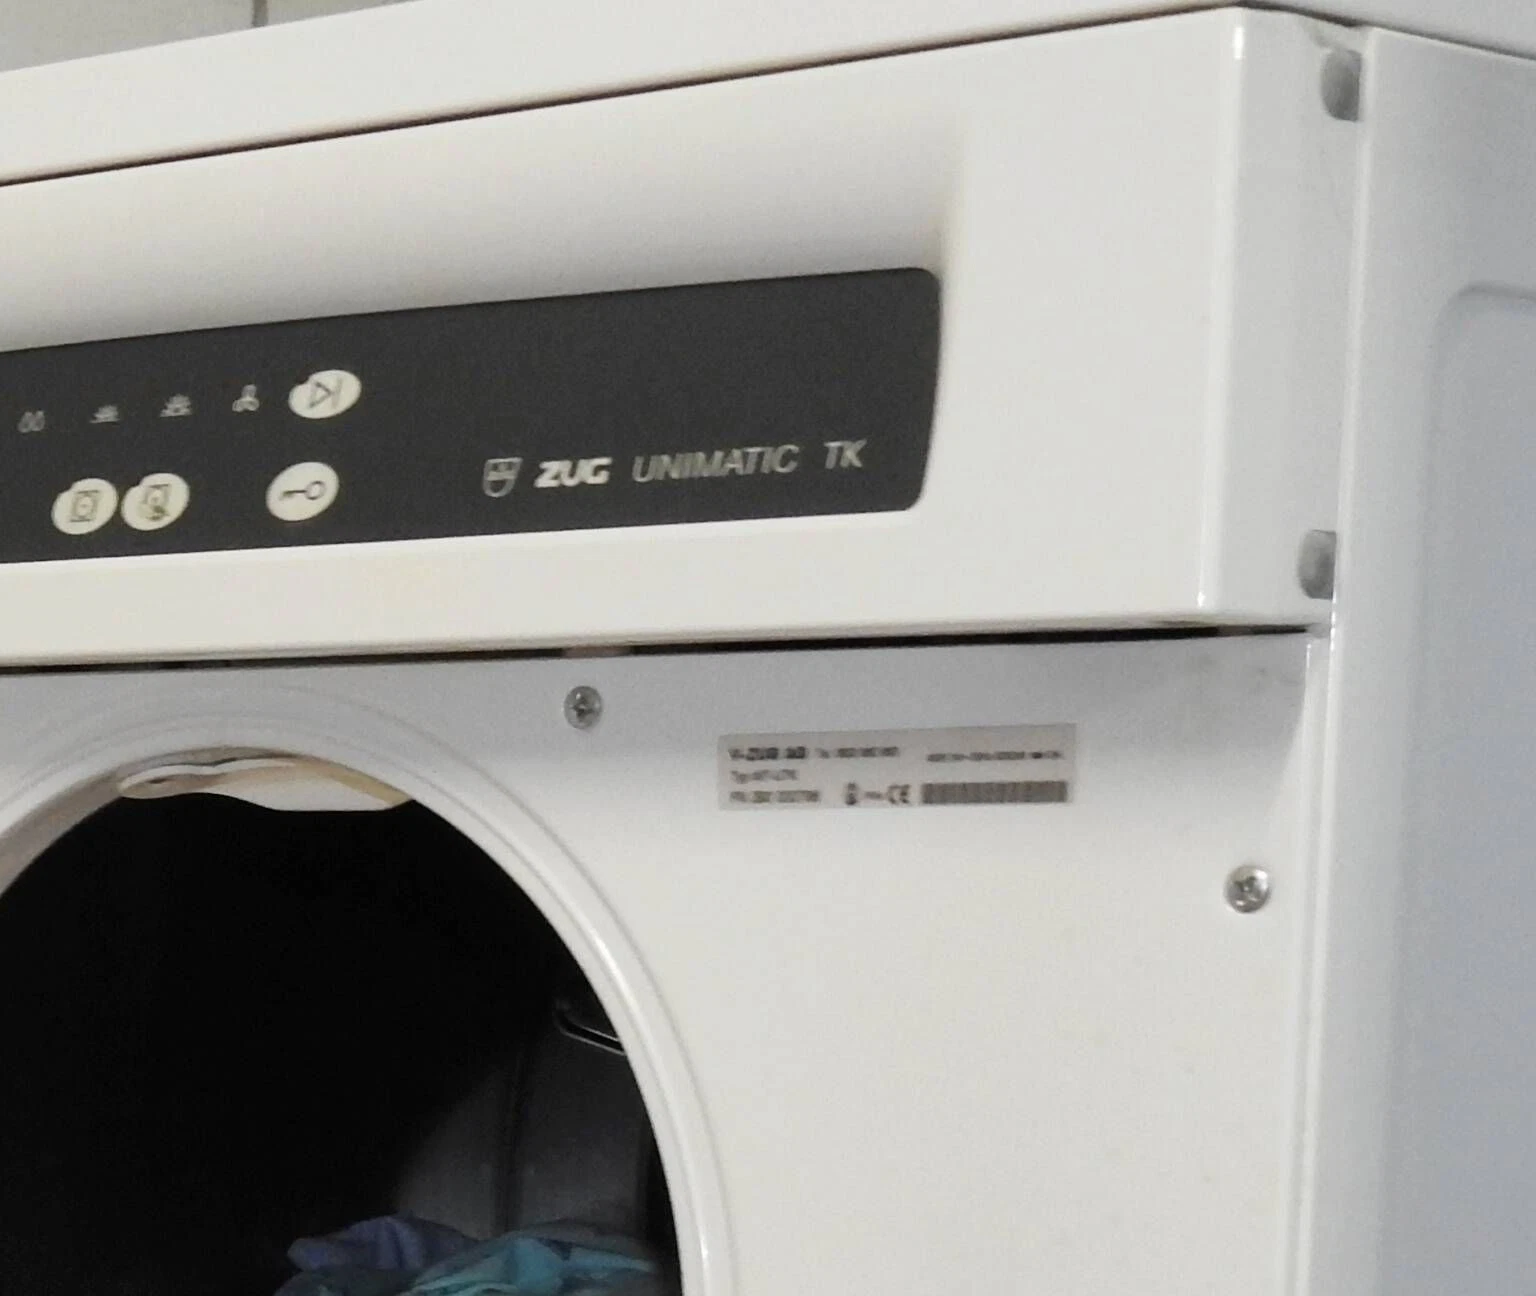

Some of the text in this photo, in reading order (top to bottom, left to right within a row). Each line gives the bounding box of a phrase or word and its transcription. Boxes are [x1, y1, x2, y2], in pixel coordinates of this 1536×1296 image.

[534, 439, 868, 488] ZUG UNIMATIC TK
